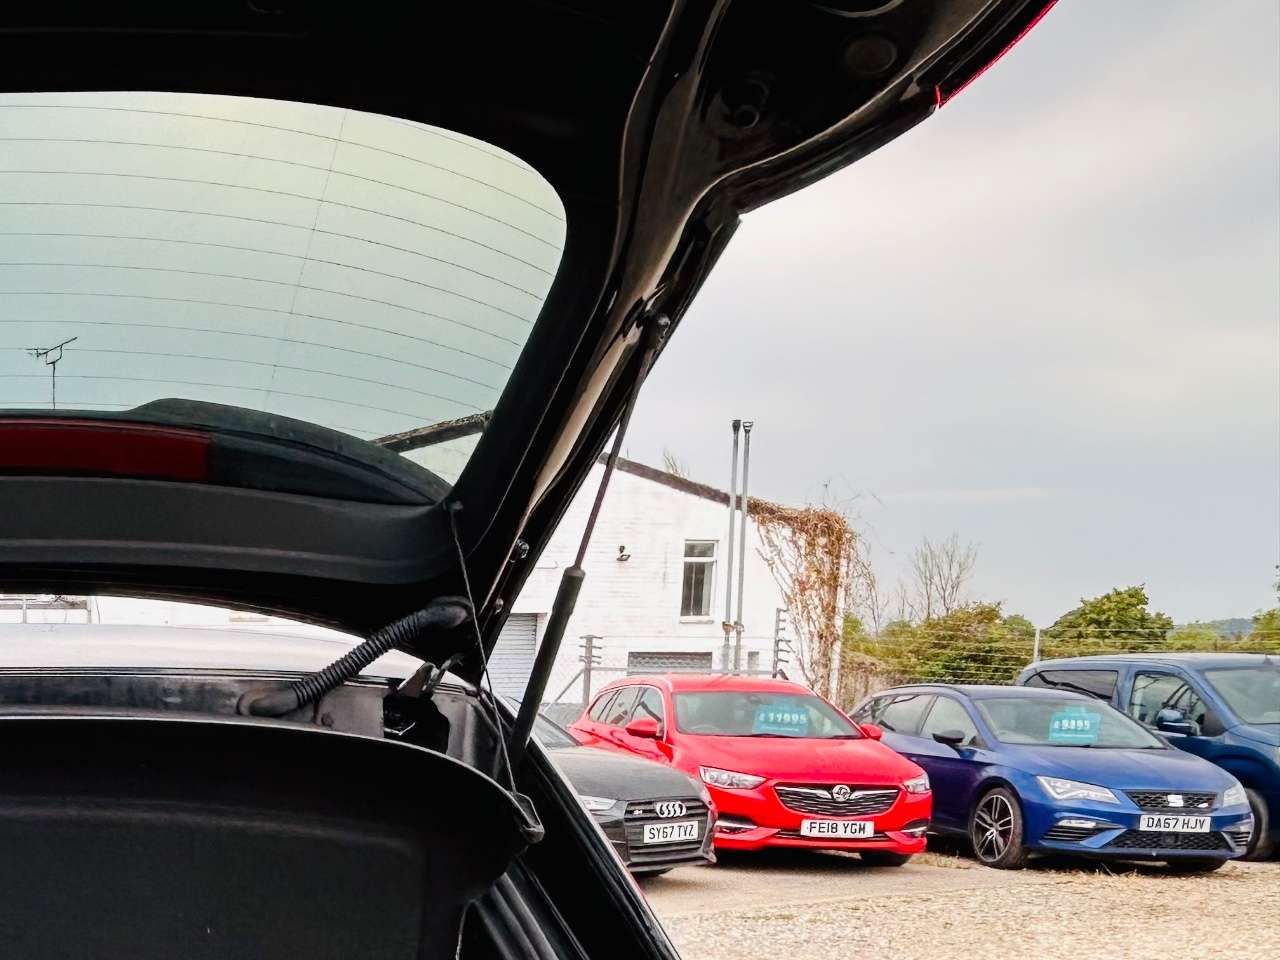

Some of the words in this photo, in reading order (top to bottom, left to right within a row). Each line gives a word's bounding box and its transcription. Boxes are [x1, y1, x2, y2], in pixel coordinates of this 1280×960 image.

[809, 821, 838, 834] FE18
[1146, 817, 1179, 829] DA67
[648, 825, 674, 840] SY67
